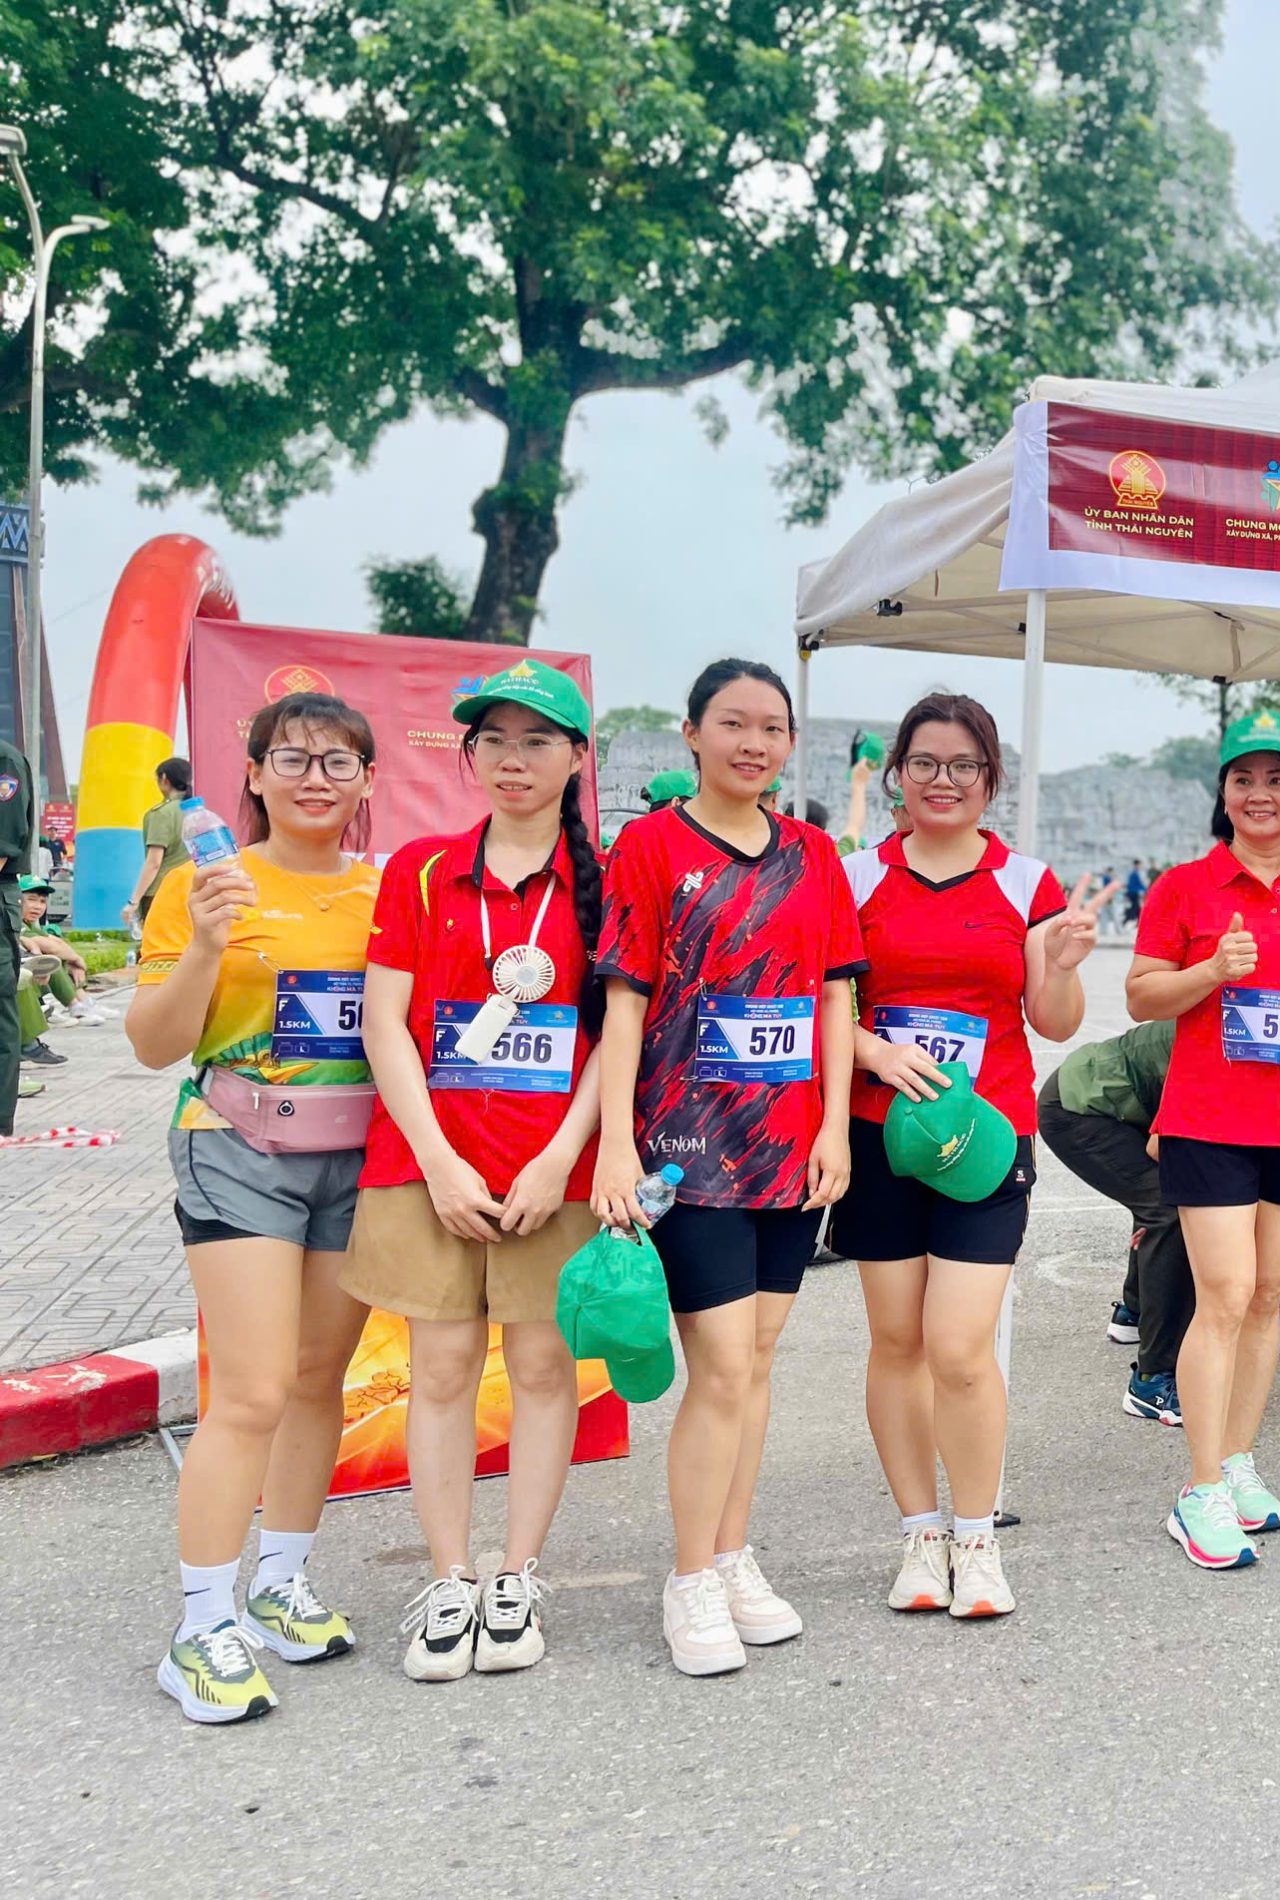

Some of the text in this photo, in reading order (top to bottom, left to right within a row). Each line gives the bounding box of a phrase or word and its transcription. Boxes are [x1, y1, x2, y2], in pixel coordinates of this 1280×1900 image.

[1084, 506, 1194, 526] ỦY BAN NHÂN DÂN
[1085, 519, 1193, 538] TỈNH THÁI NGUYÊN
[1226, 519, 1266, 530] CHUNG
[407, 730, 455, 740] CHUNG
[279, 998, 289, 1012] F
[279, 1021, 310, 1029] 1.5KM
[700, 1023, 710, 1036] F
[435, 1029, 446, 1042] F
[749, 1025, 795, 1056] 570
[492, 1032, 553, 1063] 566
[700, 1045, 728, 1054] 1.5KM
[647, 1131, 707, 1156] VENOM
